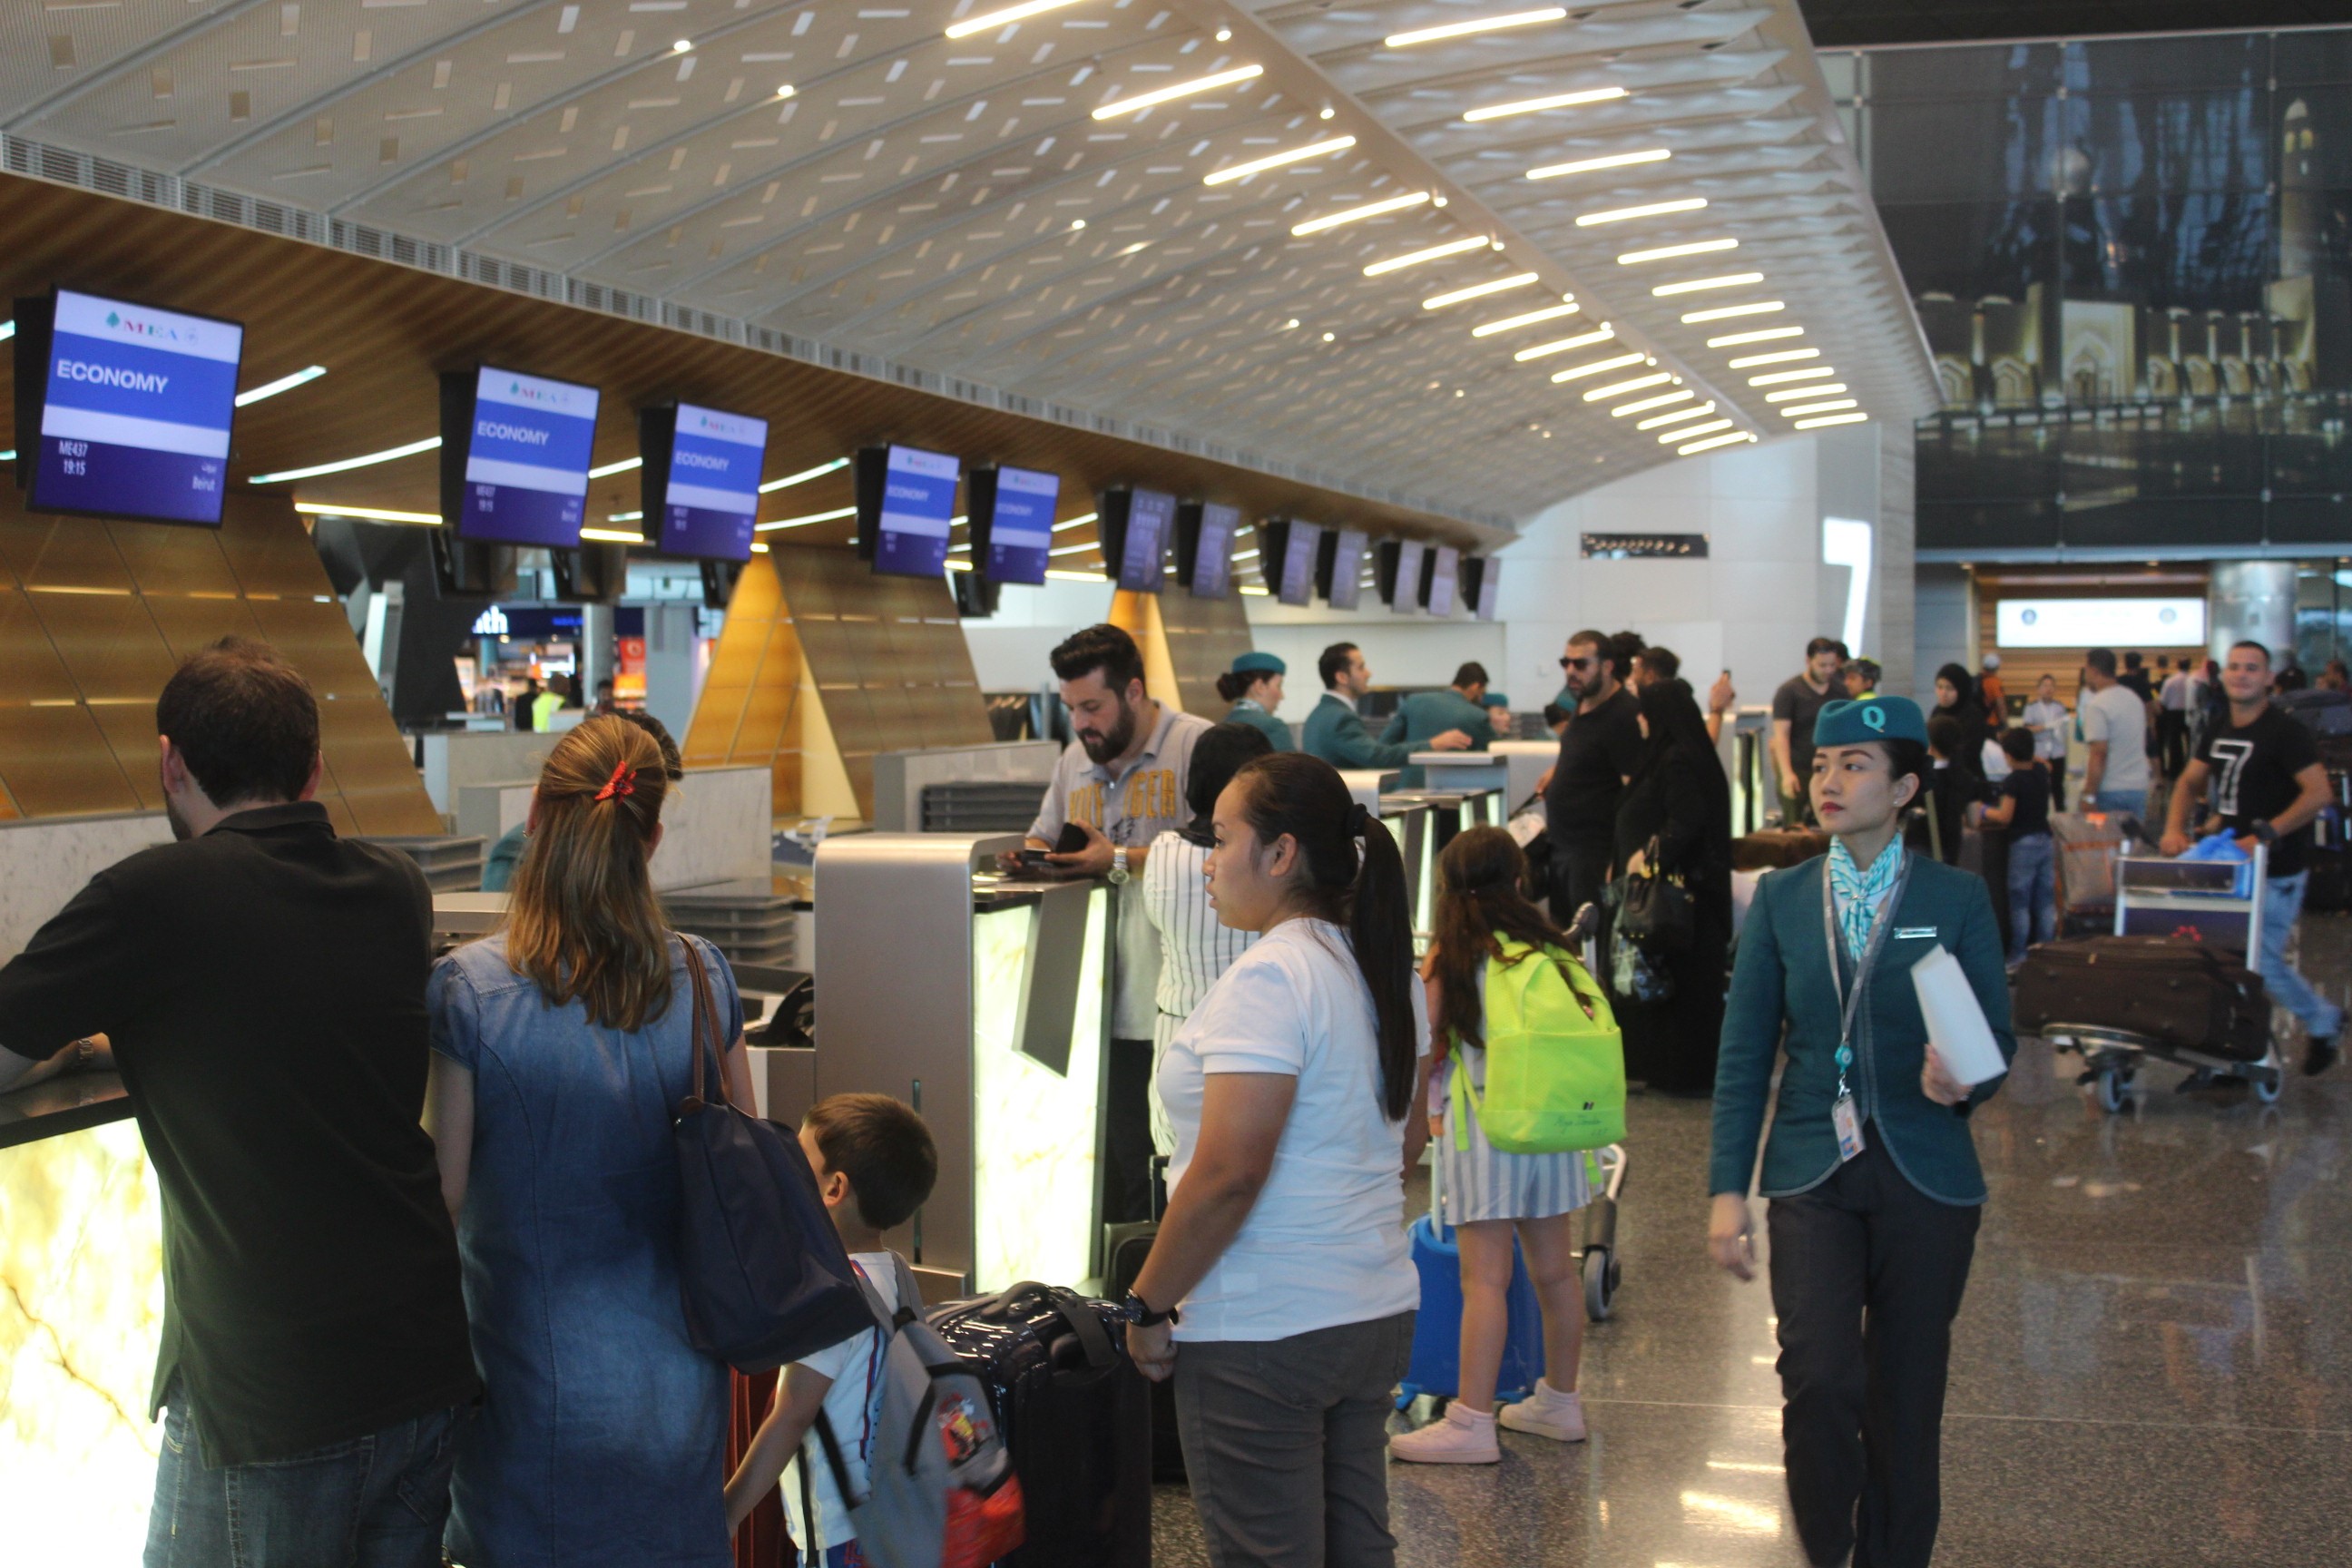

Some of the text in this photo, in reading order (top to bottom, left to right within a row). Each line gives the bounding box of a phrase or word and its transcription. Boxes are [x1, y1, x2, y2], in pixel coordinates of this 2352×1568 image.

[124, 320, 178, 341] MEA
[56, 358, 169, 394] ECONOMY
[477, 421, 550, 446] ECONOMY
[675, 450, 730, 471] ECONOMY
[1823, 516, 1872, 660] 7
[2210, 738, 2254, 816] 7
